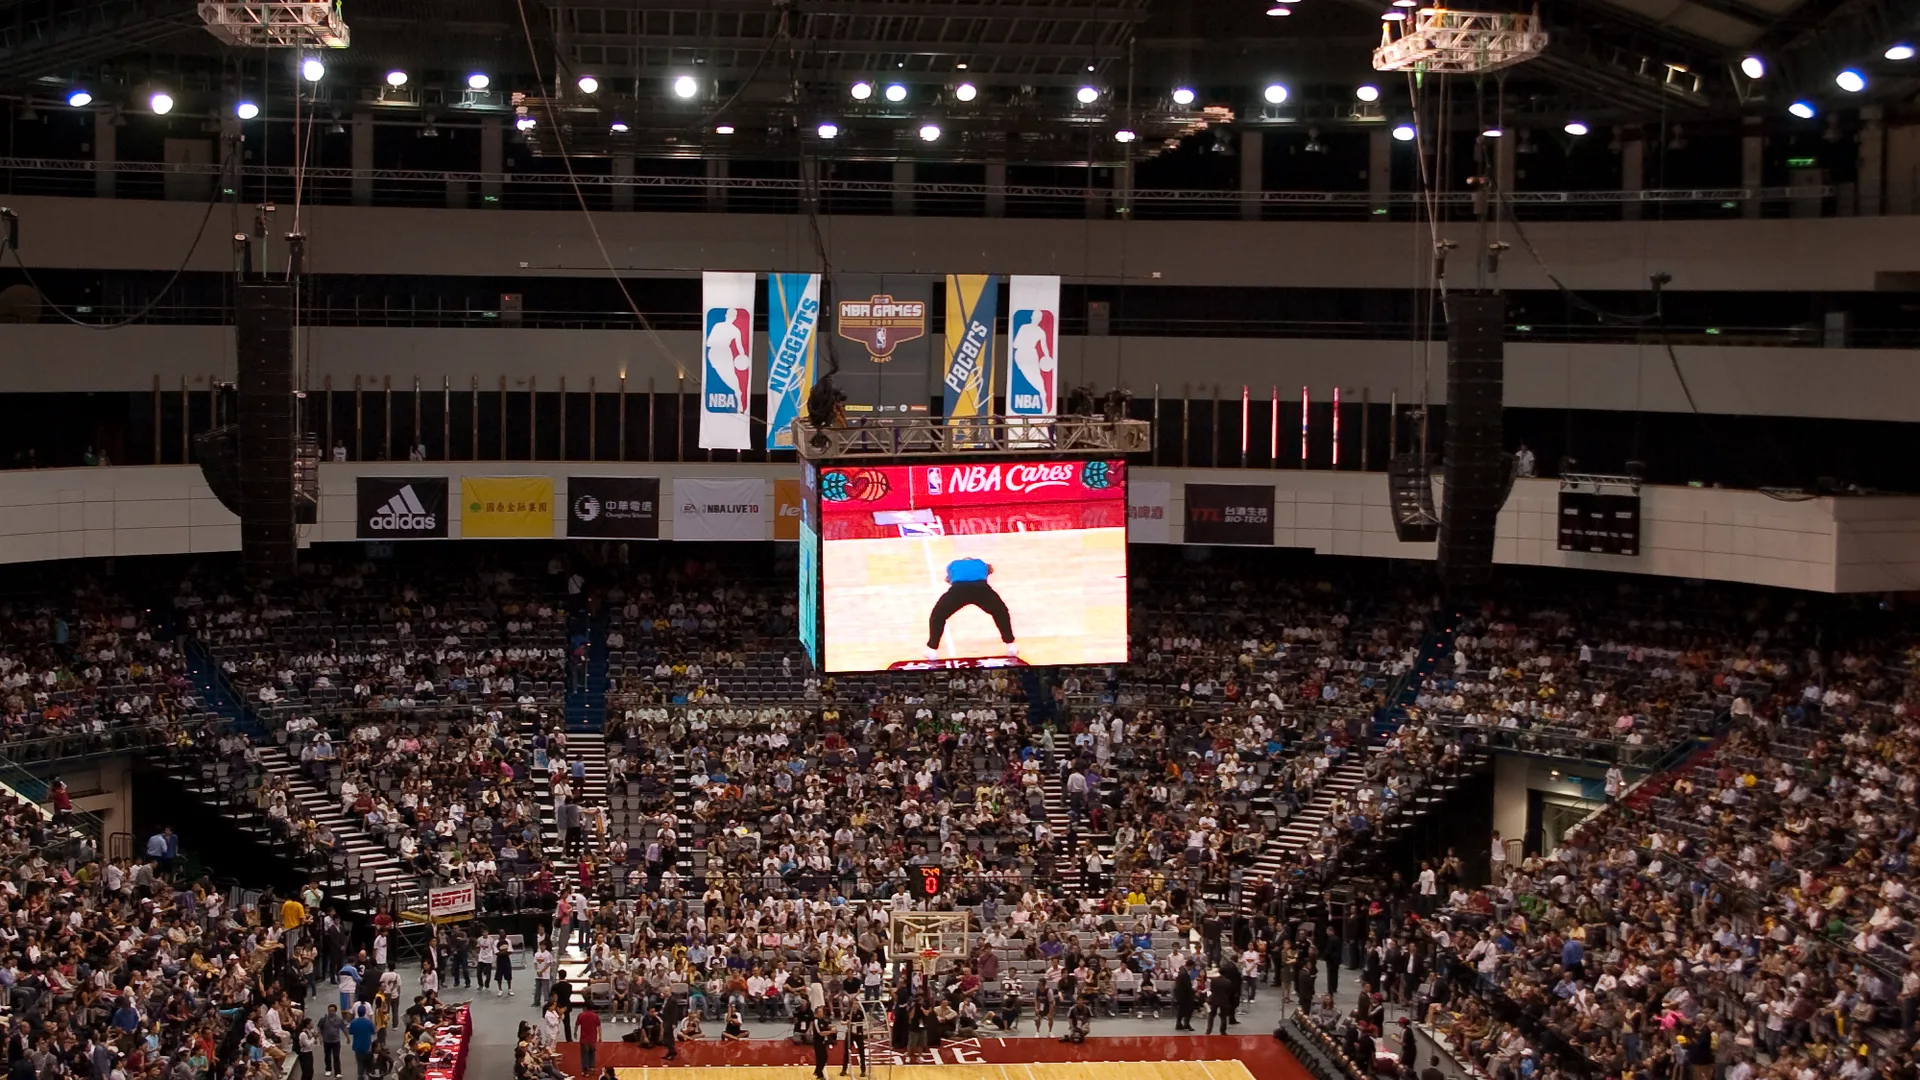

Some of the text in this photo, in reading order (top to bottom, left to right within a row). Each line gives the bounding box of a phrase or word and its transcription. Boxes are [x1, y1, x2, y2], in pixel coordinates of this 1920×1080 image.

[842, 304, 922, 317] NBA GAMES
[769, 297, 819, 395] NUGGETS
[708, 393, 736, 408] NBA
[1014, 394, 1041, 409] NBA
[948, 463, 1073, 493] NBA Cares
[707, 505, 726, 514] NBA
[727, 505, 747, 514] LIVE
[369, 513, 435, 530] adidas
[1224, 515, 1268, 524] BIO-TECH
[925, 877, 936, 894] 0
[431, 888, 472, 907] ESPN
